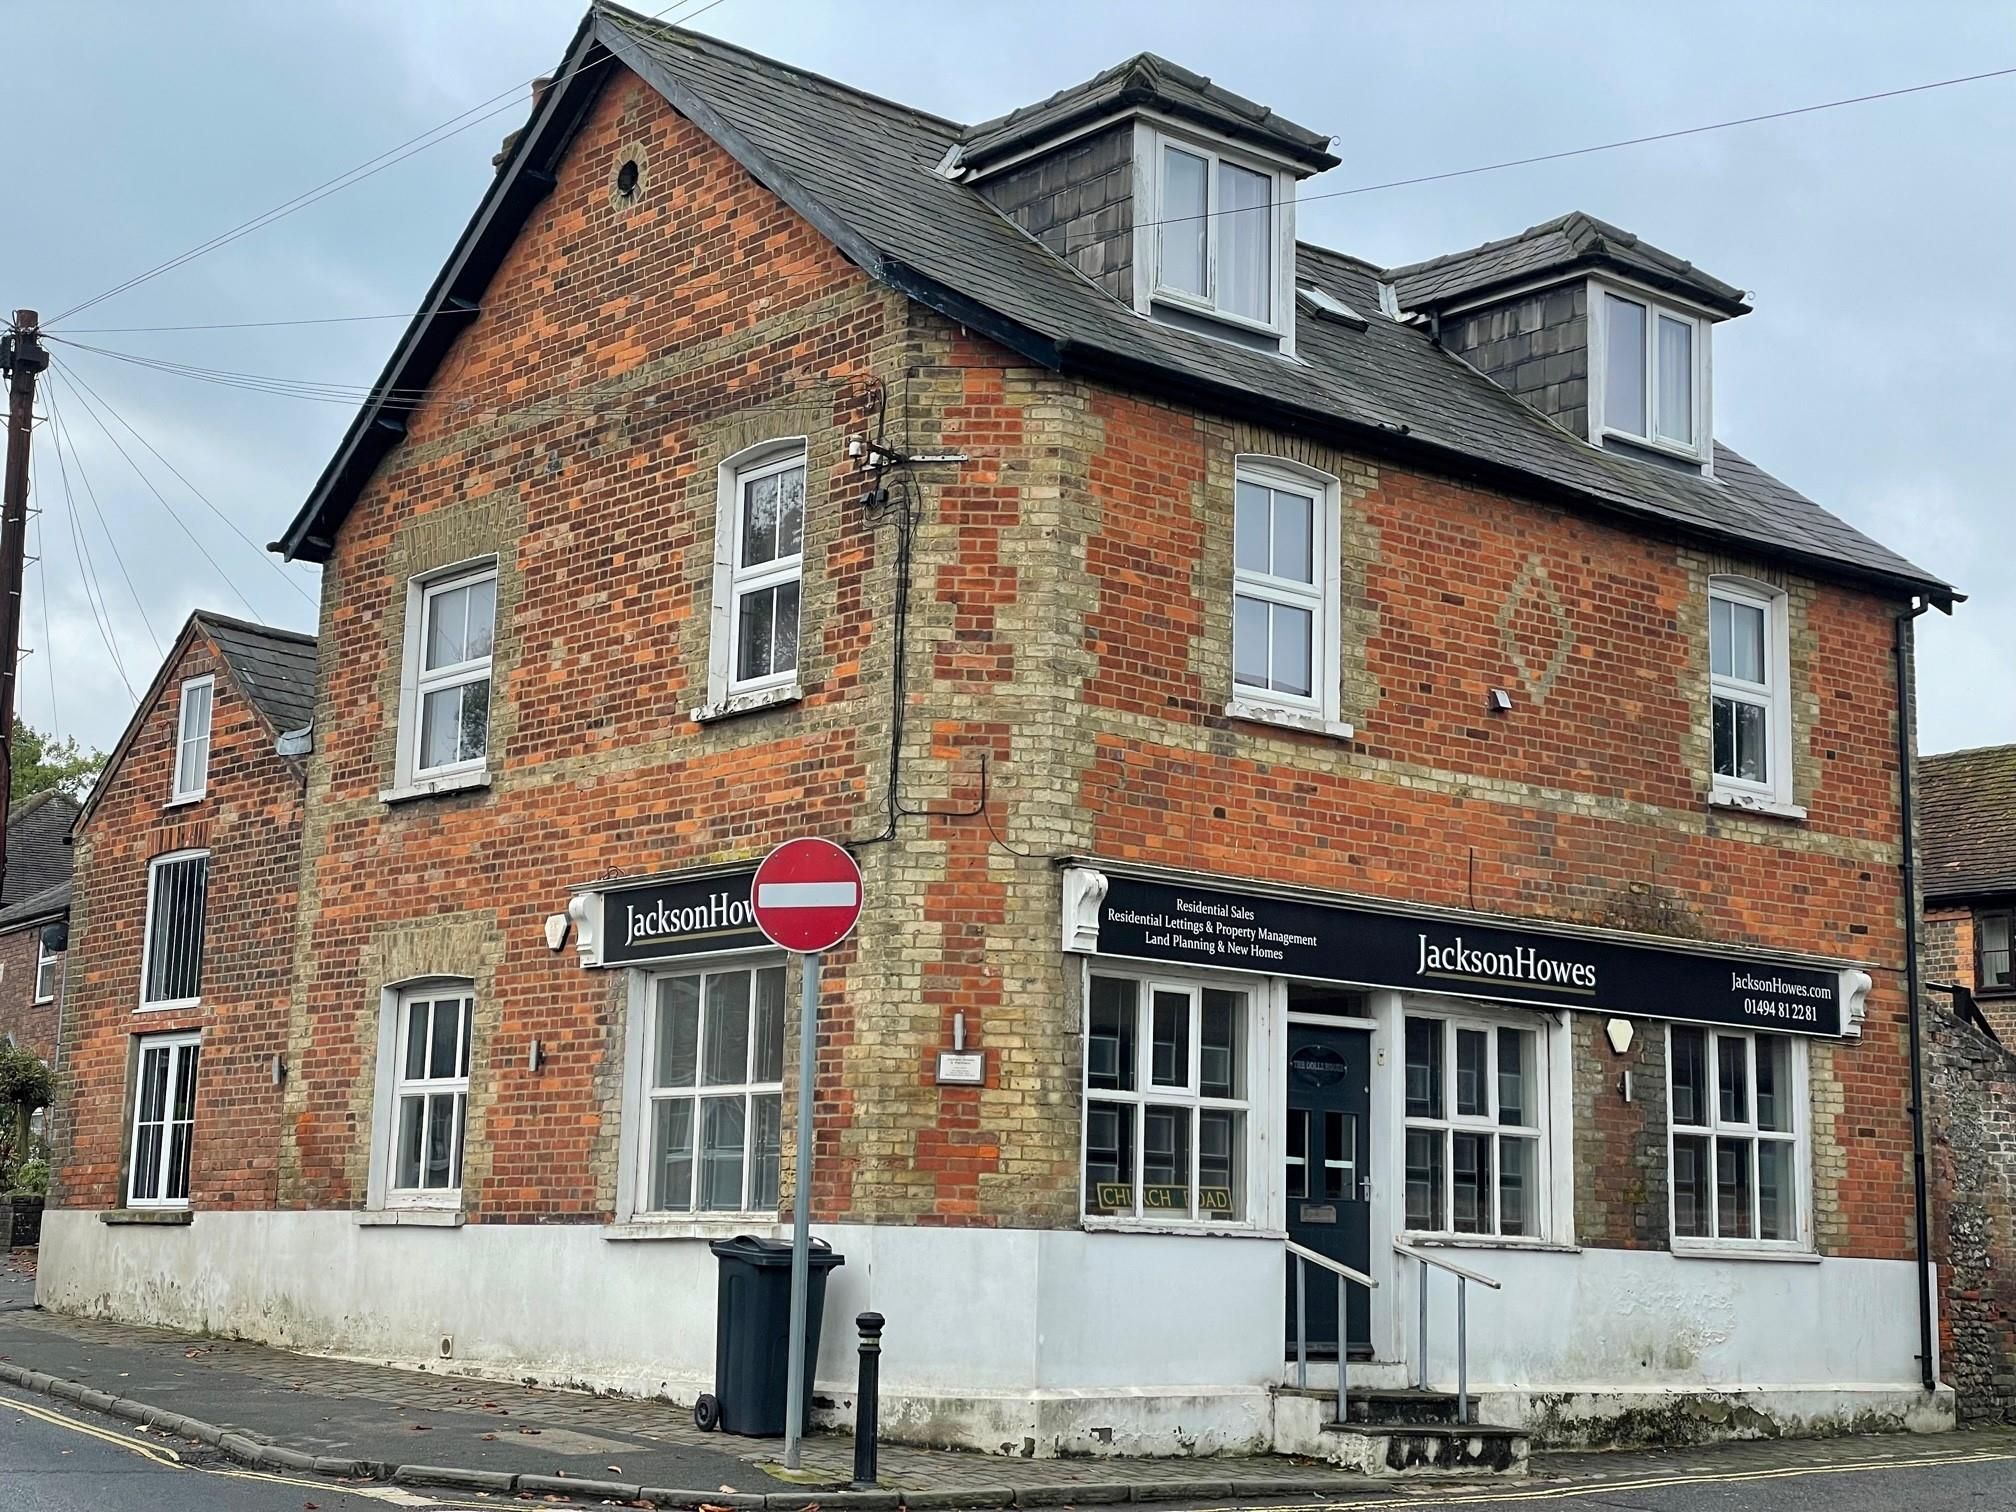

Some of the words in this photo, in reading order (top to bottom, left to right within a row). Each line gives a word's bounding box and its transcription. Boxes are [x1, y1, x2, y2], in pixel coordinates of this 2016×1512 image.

[625, 893, 753, 946] JacksonHo
[1176, 898, 1229, 917] Residential
[1230, 906, 1255, 921] Sales
[1108, 908, 1162, 927] Residential
[1165, 915, 1204, 934] Lettings
[1205, 921, 1214, 933] &
[1216, 922, 1256, 941] Property
[1258, 928, 1317, 947] Management
[1145, 931, 1170, 946] Land
[1172, 934, 1215, 954] Planning
[1217, 940, 1225, 953] &
[1227, 942, 1249, 955] New
[1250, 945, 1283, 960] Homes
[1416, 934, 1596, 986] JacksonHowes
[1731, 972, 1832, 999] JacksonHowes.com
[1744, 998, 1776, 1016] 01494
[1103, 1188, 1171, 1206] CHCH
